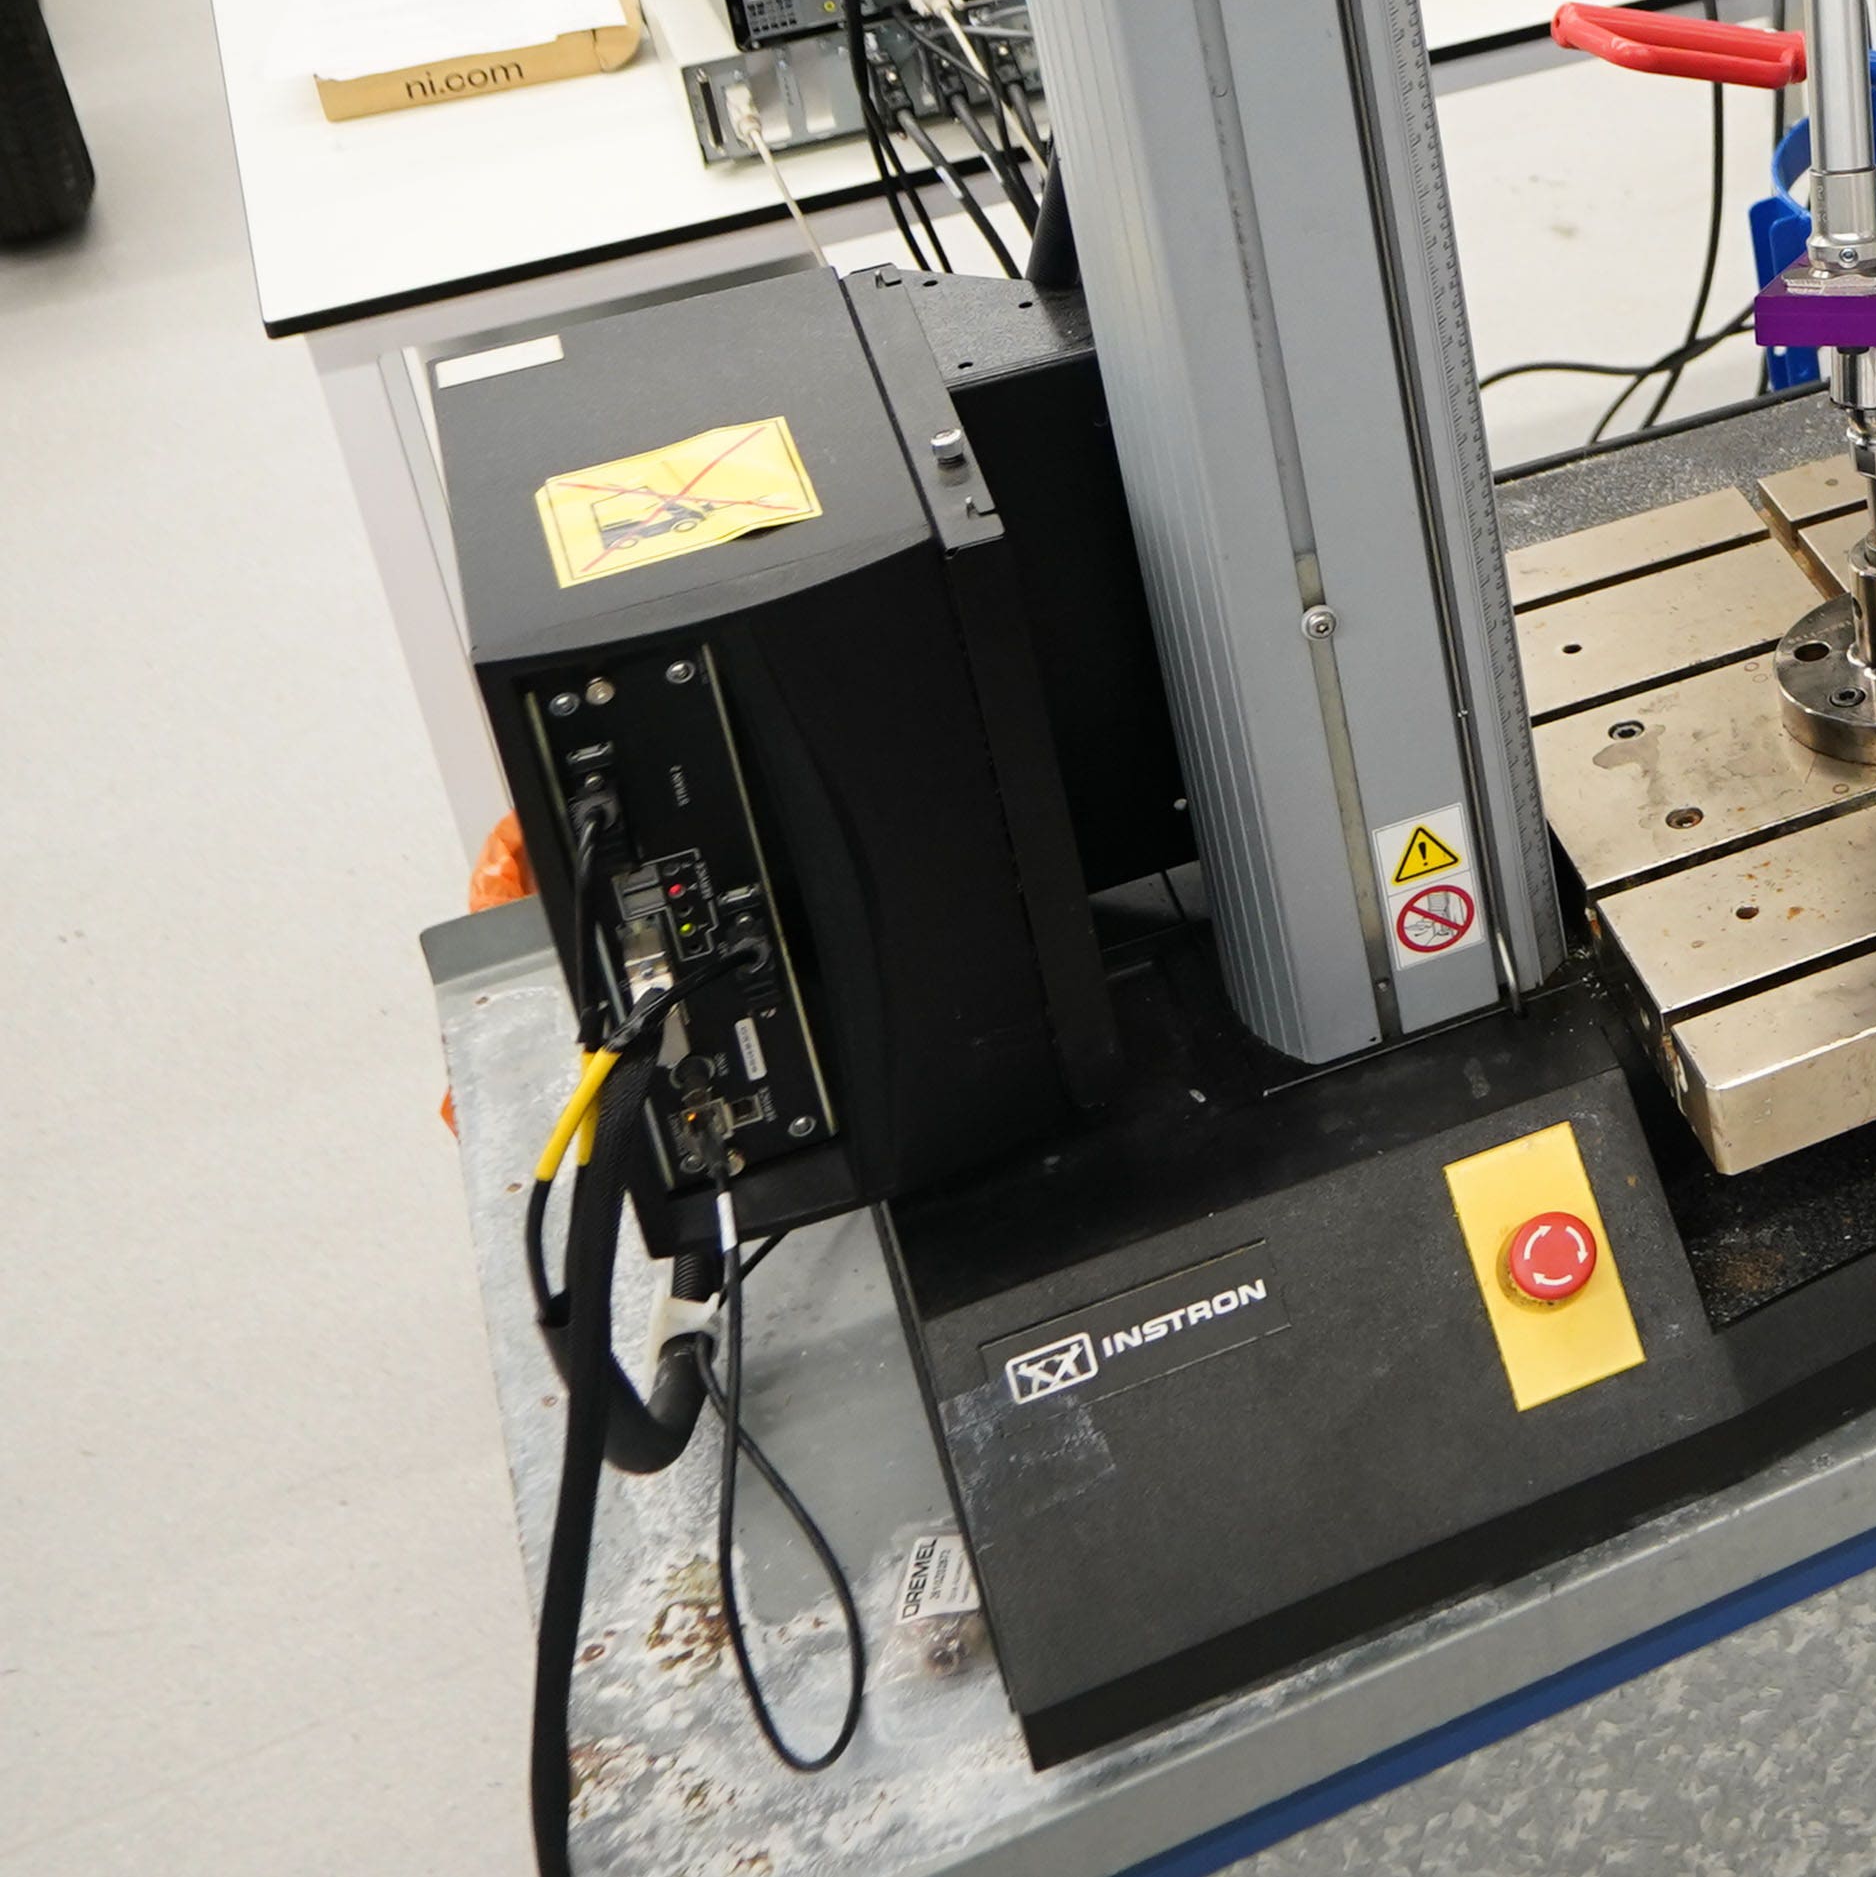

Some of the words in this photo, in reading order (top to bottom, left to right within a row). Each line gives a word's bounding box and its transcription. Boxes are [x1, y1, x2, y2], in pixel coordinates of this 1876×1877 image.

[403, 55, 526, 103] ni.com
[1100, 1277, 1268, 1358] INSTRON
[901, 1536, 938, 1620] DREMEL
